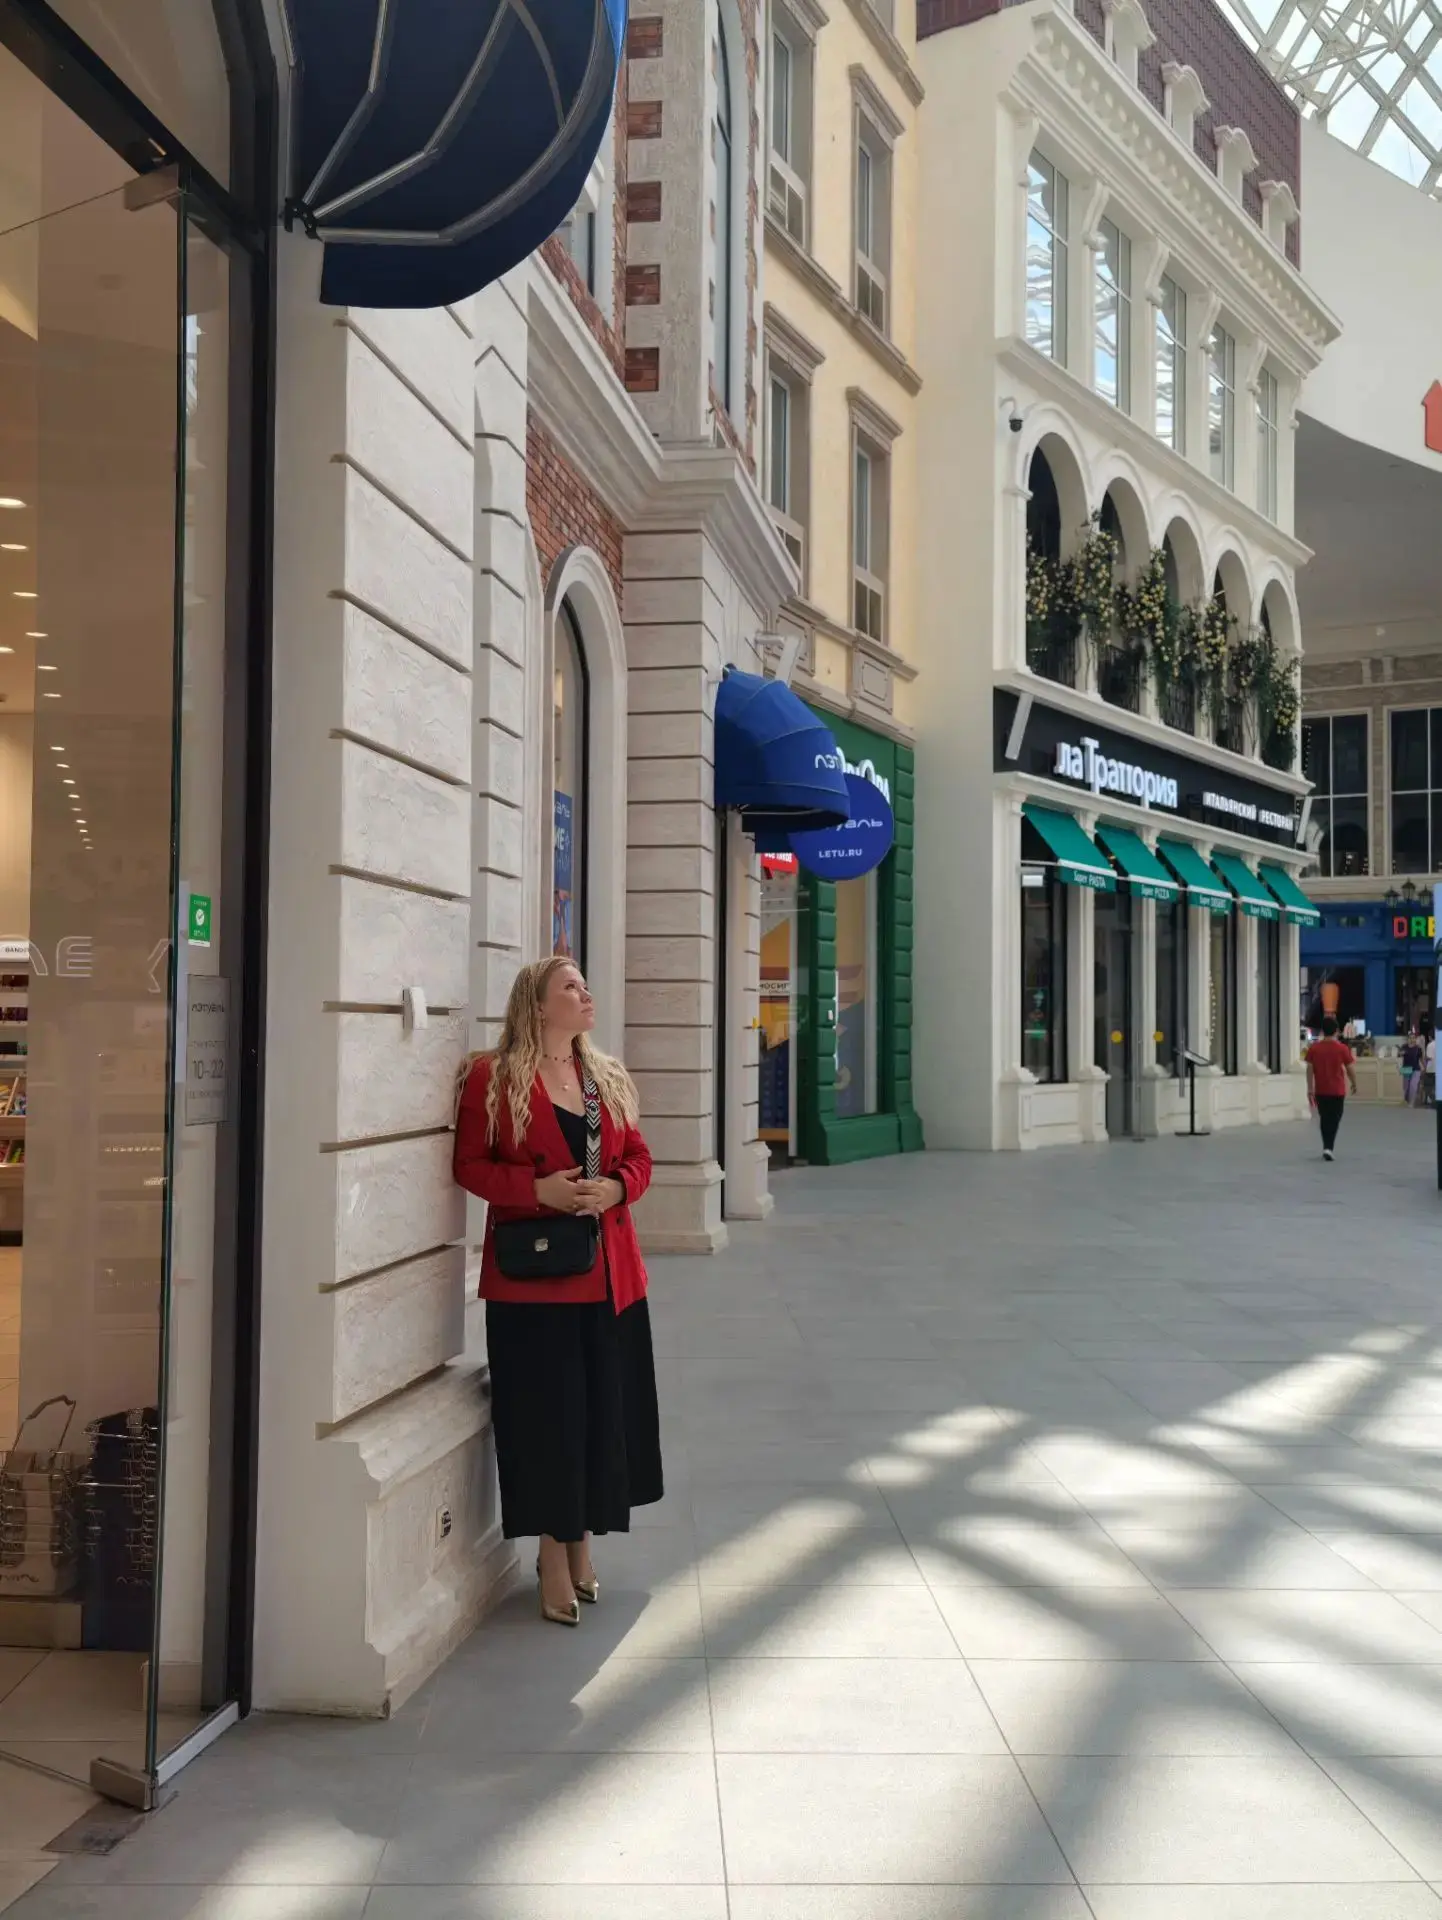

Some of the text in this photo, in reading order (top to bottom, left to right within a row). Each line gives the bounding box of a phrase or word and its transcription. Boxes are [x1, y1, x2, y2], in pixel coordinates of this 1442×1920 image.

[818, 848, 863, 859] LETU.RU
[1088, 874, 1107, 889] PASTA
[192, 1060, 225, 1080] 10-22
